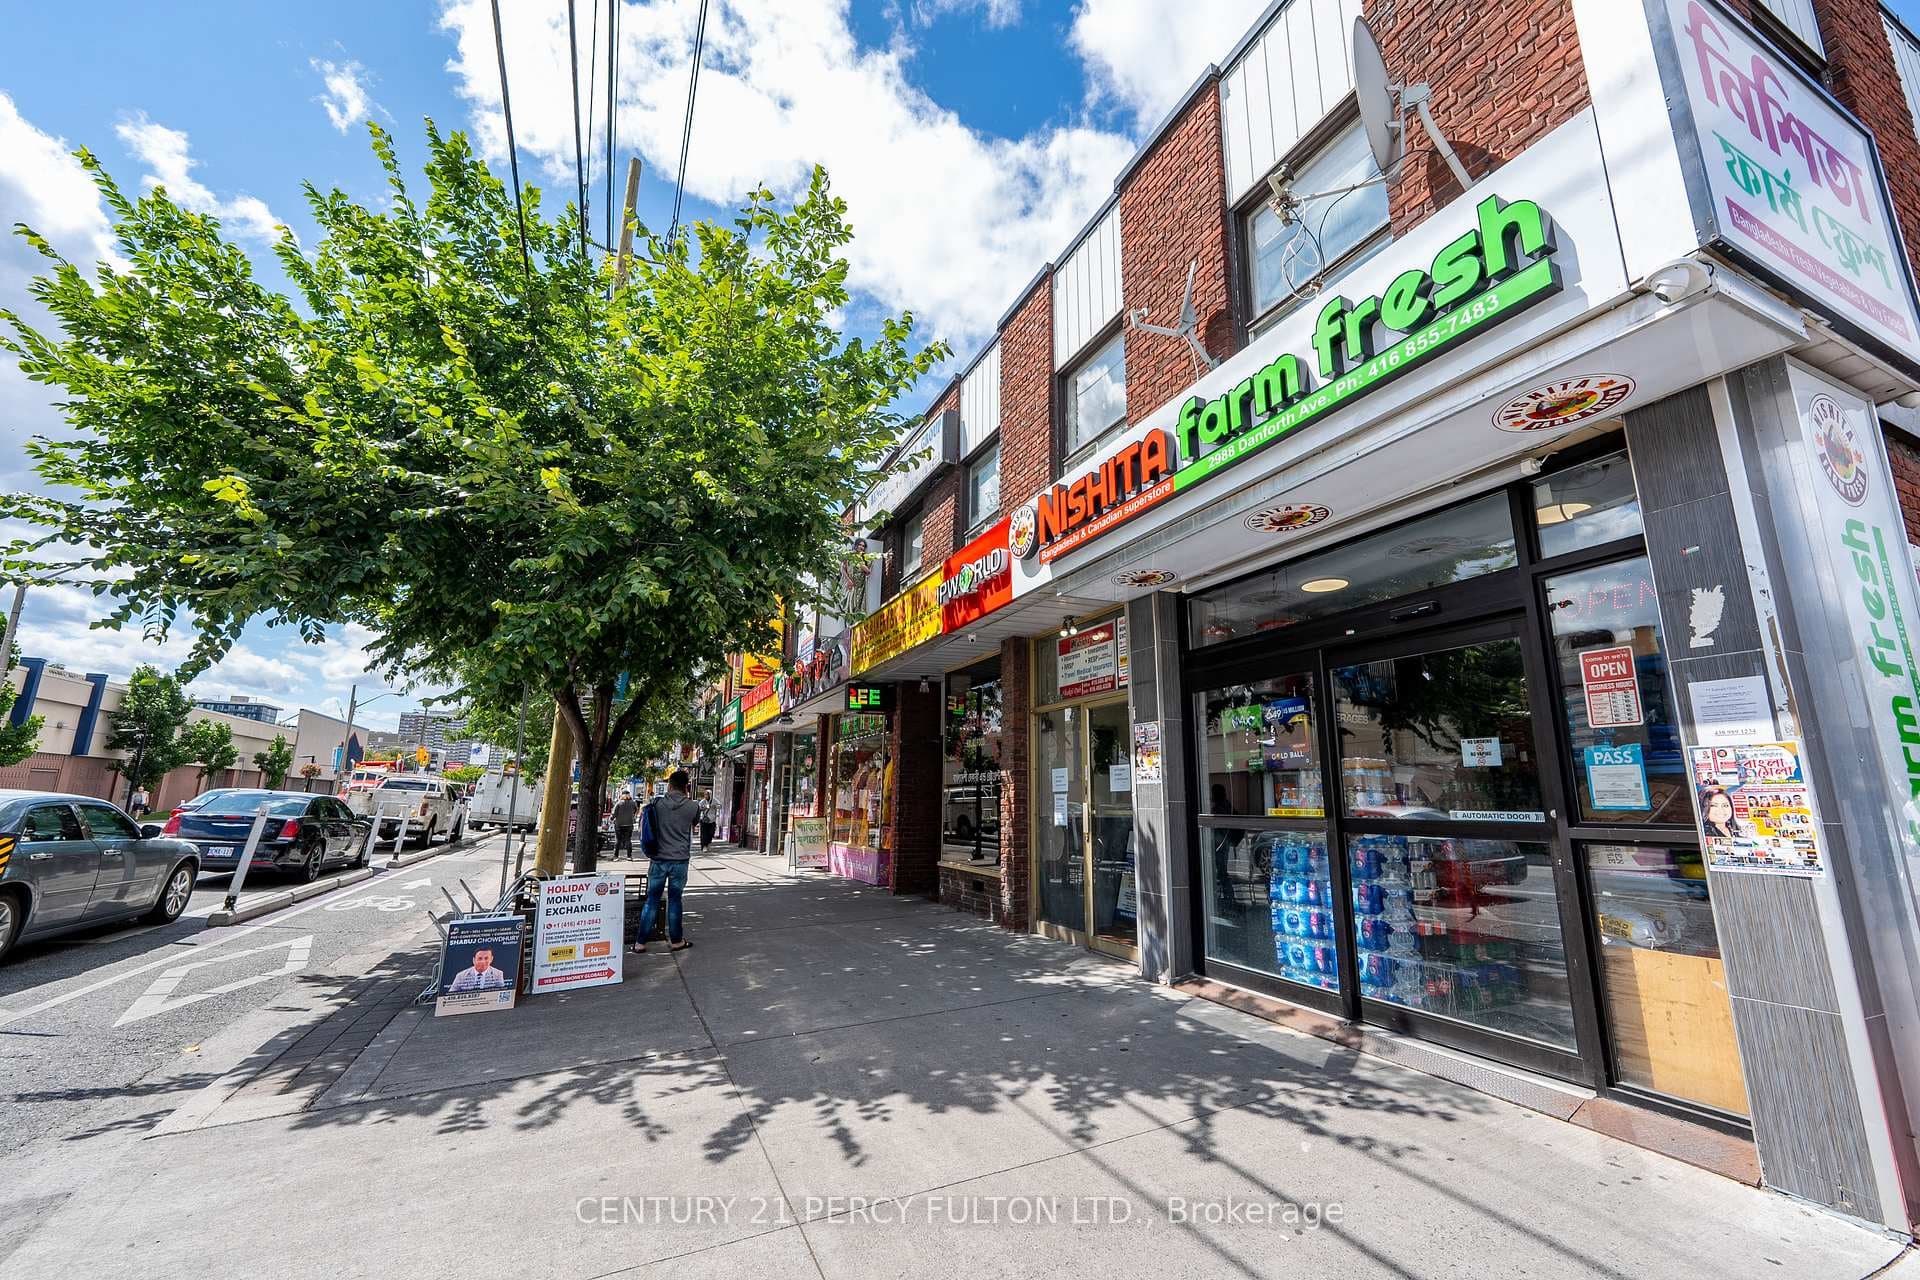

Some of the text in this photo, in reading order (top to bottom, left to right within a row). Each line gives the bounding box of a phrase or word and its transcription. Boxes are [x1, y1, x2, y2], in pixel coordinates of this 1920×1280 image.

[1684, 1, 1872, 224] নিশিতা
[1731, 207, 1790, 257] Bangladeshi
[1790, 247, 1815, 273] Fresh
[1176, 194, 1549, 461] farm fresh
[1208, 294, 1499, 469] 2988 Danforth Ave. Ph: 416 855-7483
[1503, 378, 1591, 421] NISHITA
[1814, 402, 1854, 442] NISHITA
[1038, 428, 1172, 545] NISHITA
[1041, 482, 1171, 561] Bangladeshi & Canadian superstore
[1841, 517, 1904, 679] fresh
[1590, 660, 1628, 678] OPEN
[1265, 708, 1282, 720] 649
[1336, 712, 1369, 725] ERAGES
[1593, 751, 1633, 766] PASS
[1462, 812, 1505, 820] AUTOMATIC
[546, 894, 583, 905] MONEY
[547, 883, 591, 894] HOLIDAY
[545, 904, 602, 916] EXCHANGE
[449, 935, 520, 946] SHABUJ CHOWDHURY
